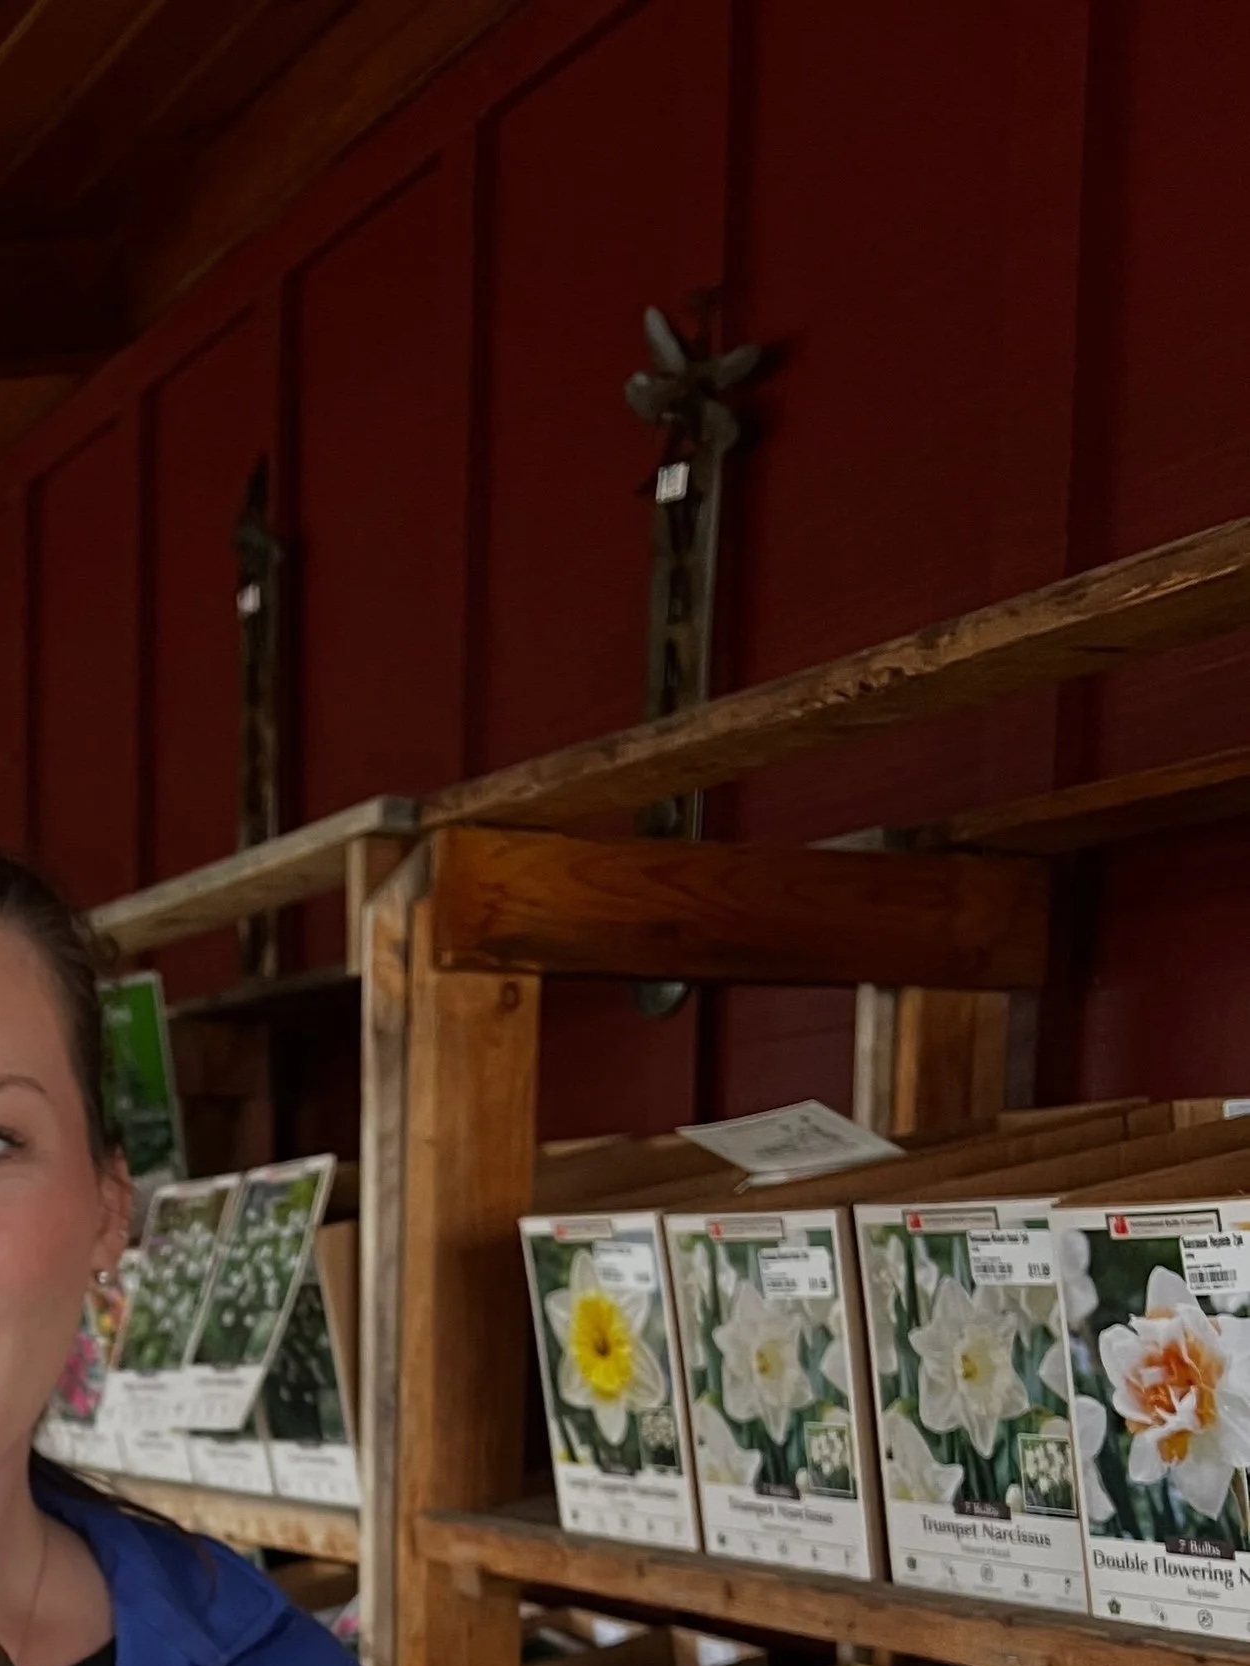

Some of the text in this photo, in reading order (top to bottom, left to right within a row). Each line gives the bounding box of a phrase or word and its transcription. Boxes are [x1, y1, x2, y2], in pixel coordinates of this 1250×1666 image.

[920, 1513, 1052, 1548] Trumpet Narcissus
[1190, 1539, 1222, 1557] Bulbs
[1093, 1548, 1150, 1574] Double
[1154, 1556, 1235, 1590] Flowering
